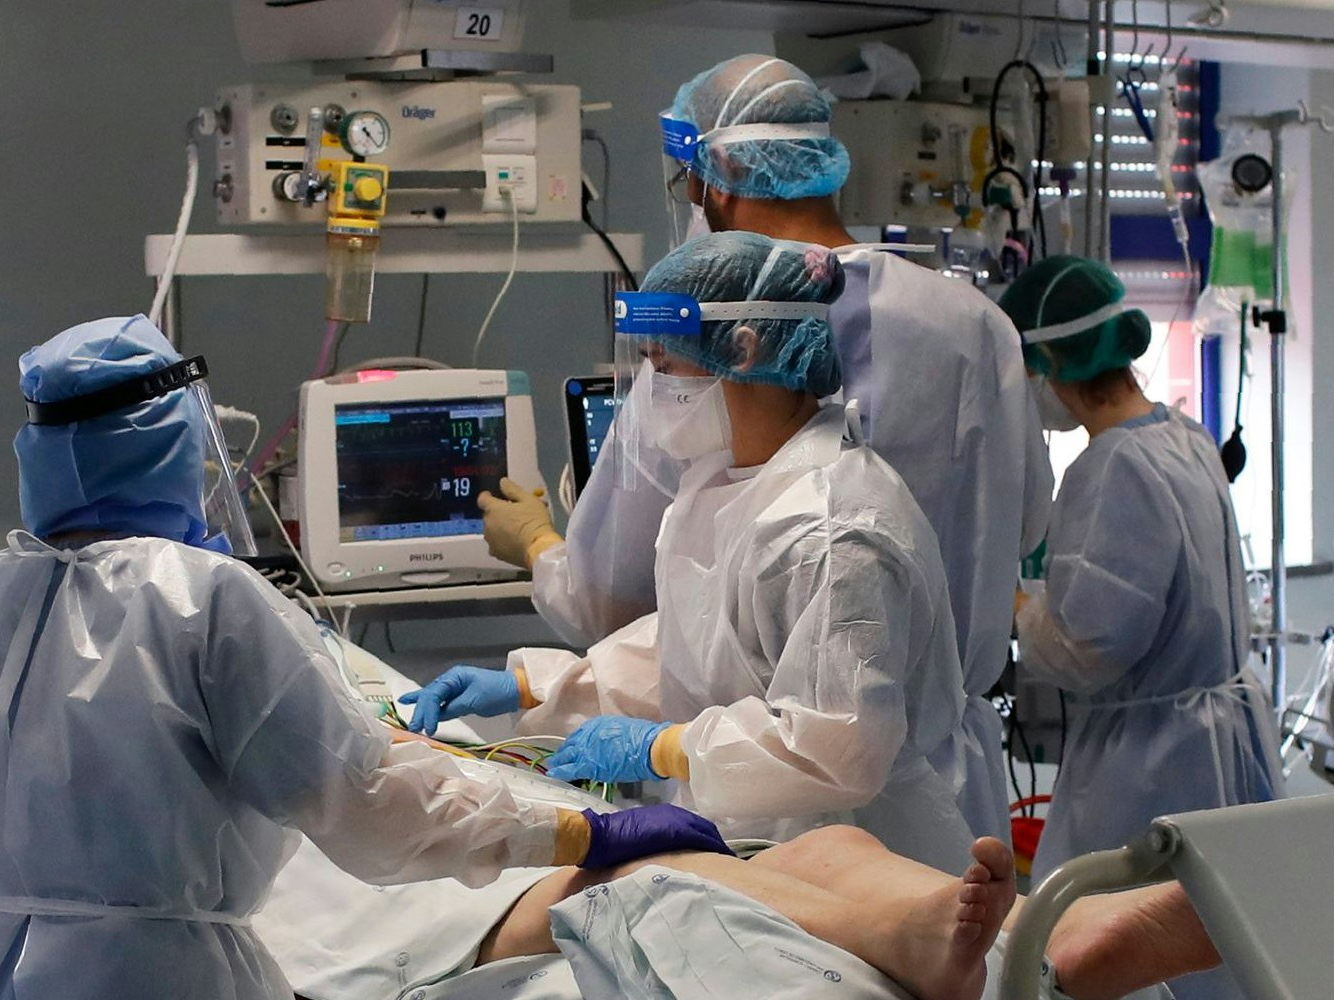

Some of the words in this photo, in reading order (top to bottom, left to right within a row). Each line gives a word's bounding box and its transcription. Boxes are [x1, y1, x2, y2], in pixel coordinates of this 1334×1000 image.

[466, 13, 491, 36] 20
[402, 105, 436, 121] Dräger
[451, 421, 473, 438] 113
[453, 477, 471, 497] 19
[409, 553, 444, 562] PHILIPS
